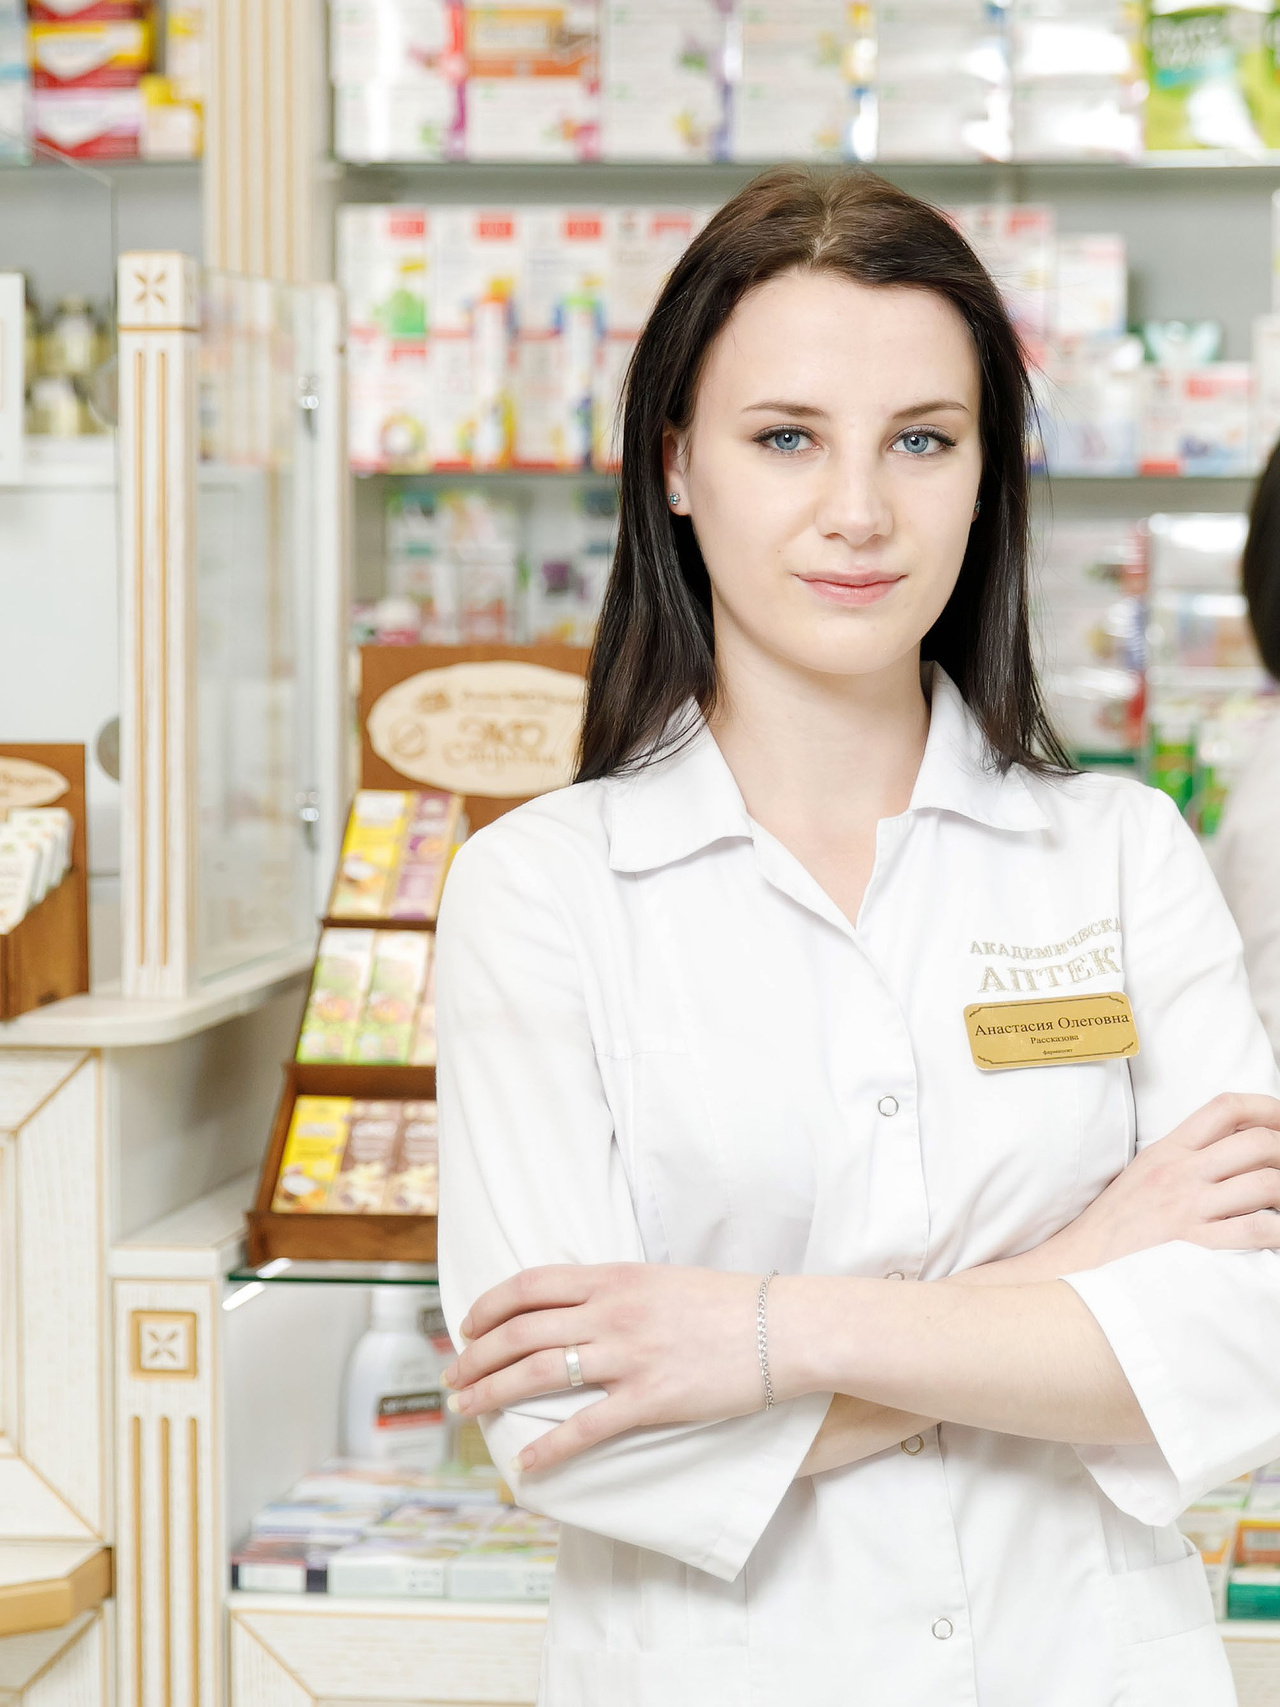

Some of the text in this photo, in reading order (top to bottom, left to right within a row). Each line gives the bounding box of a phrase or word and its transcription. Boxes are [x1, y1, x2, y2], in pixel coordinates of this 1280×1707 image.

[975, 1013, 1130, 1037] Анастасия Олеговна
[1030, 1034, 1080, 1045] Рассказова
